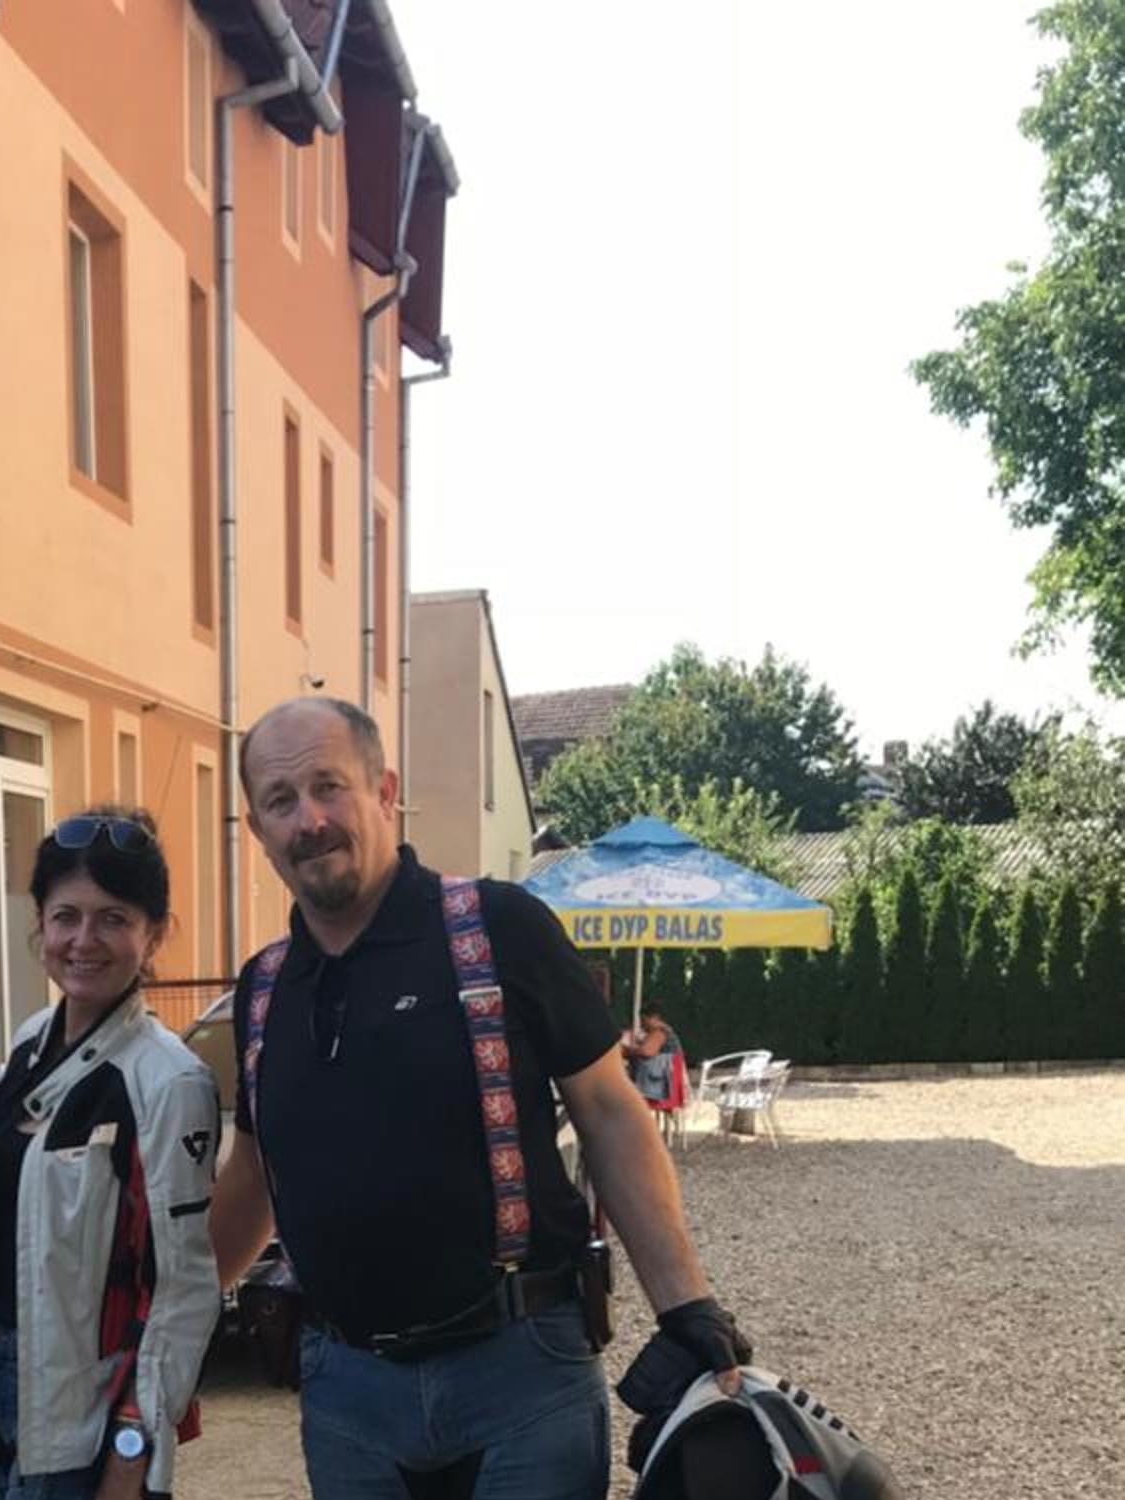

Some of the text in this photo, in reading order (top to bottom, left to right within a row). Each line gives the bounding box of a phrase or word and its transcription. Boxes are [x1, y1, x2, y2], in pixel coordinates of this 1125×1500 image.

[574, 914, 723, 941] ICE DYP BALAS
